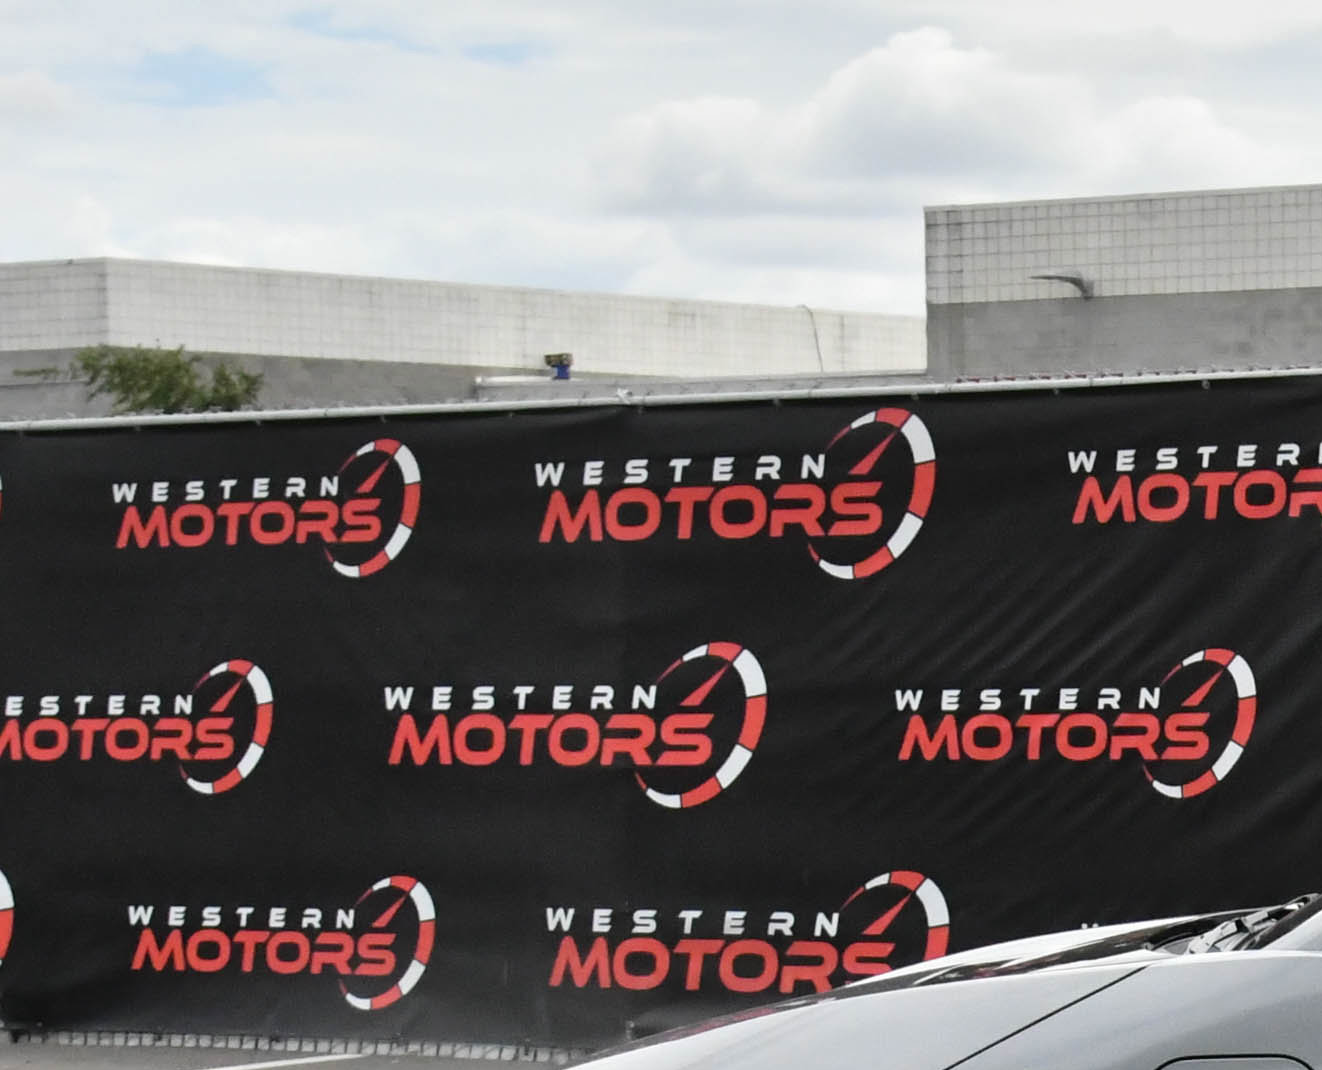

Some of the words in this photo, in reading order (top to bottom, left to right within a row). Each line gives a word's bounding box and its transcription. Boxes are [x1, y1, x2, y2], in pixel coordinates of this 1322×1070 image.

[535, 454, 825, 486] WESTERN
[113, 476, 338, 503] WESTERN
[116, 498, 382, 549] MOTORS
[540, 482, 882, 542] MOTORS
[5, 695, 192, 716] ESTERN
[385, 685, 656, 710] WESTERN
[895, 687, 1160, 711] WESTERN
[389, 713, 714, 766] MOTORS
[899, 712, 1210, 761] MOTORS
[129, 906, 354, 928] WESTERN
[547, 908, 839, 936] WESTERN
[132, 929, 396, 976] MOTORS
[550, 936, 895, 992] MOTORS
